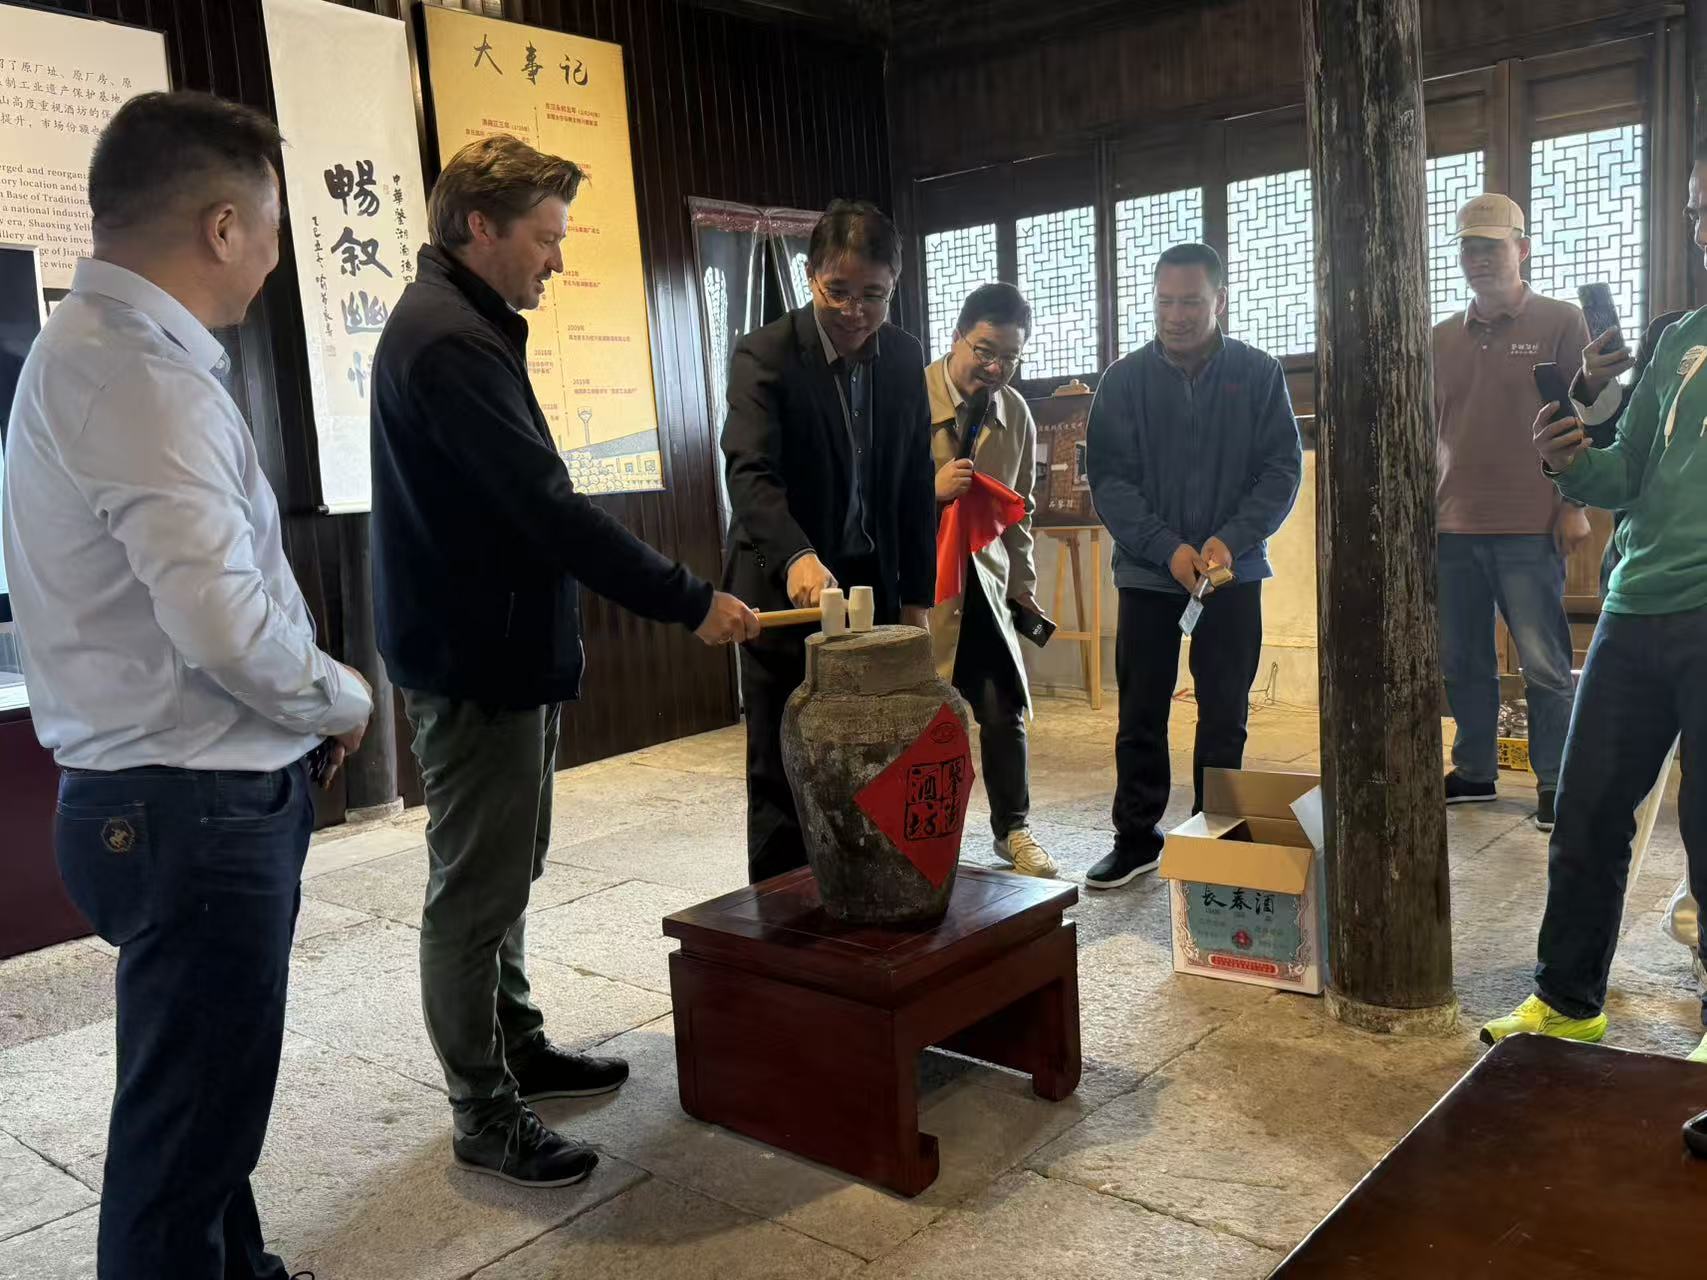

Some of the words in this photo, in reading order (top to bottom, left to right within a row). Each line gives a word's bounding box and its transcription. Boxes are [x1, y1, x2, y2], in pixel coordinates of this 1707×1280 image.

[473, 33, 589, 86] 大事记
[0, 76, 122, 104] 制工业遗产保护基地
[27, 167, 44, 175] and
[47, 169, 89, 180] reorgani
[20, 178, 58, 190] location
[60, 183, 77, 192] and
[7, 190, 28, 200] Base
[30, 193, 40, 201] of
[11, 205, 50, 215] national
[7, 219, 26, 227] era,
[28, 219, 72, 232] Shaoxing
[73, 222, 92, 231] Yell
[27, 233, 44, 241] and
[47, 233, 68, 243] have
[50, 260, 73, 269] wine
[323, 159, 393, 399] 暢叙幽
[1202, 886, 1275, 915] 长春酒
